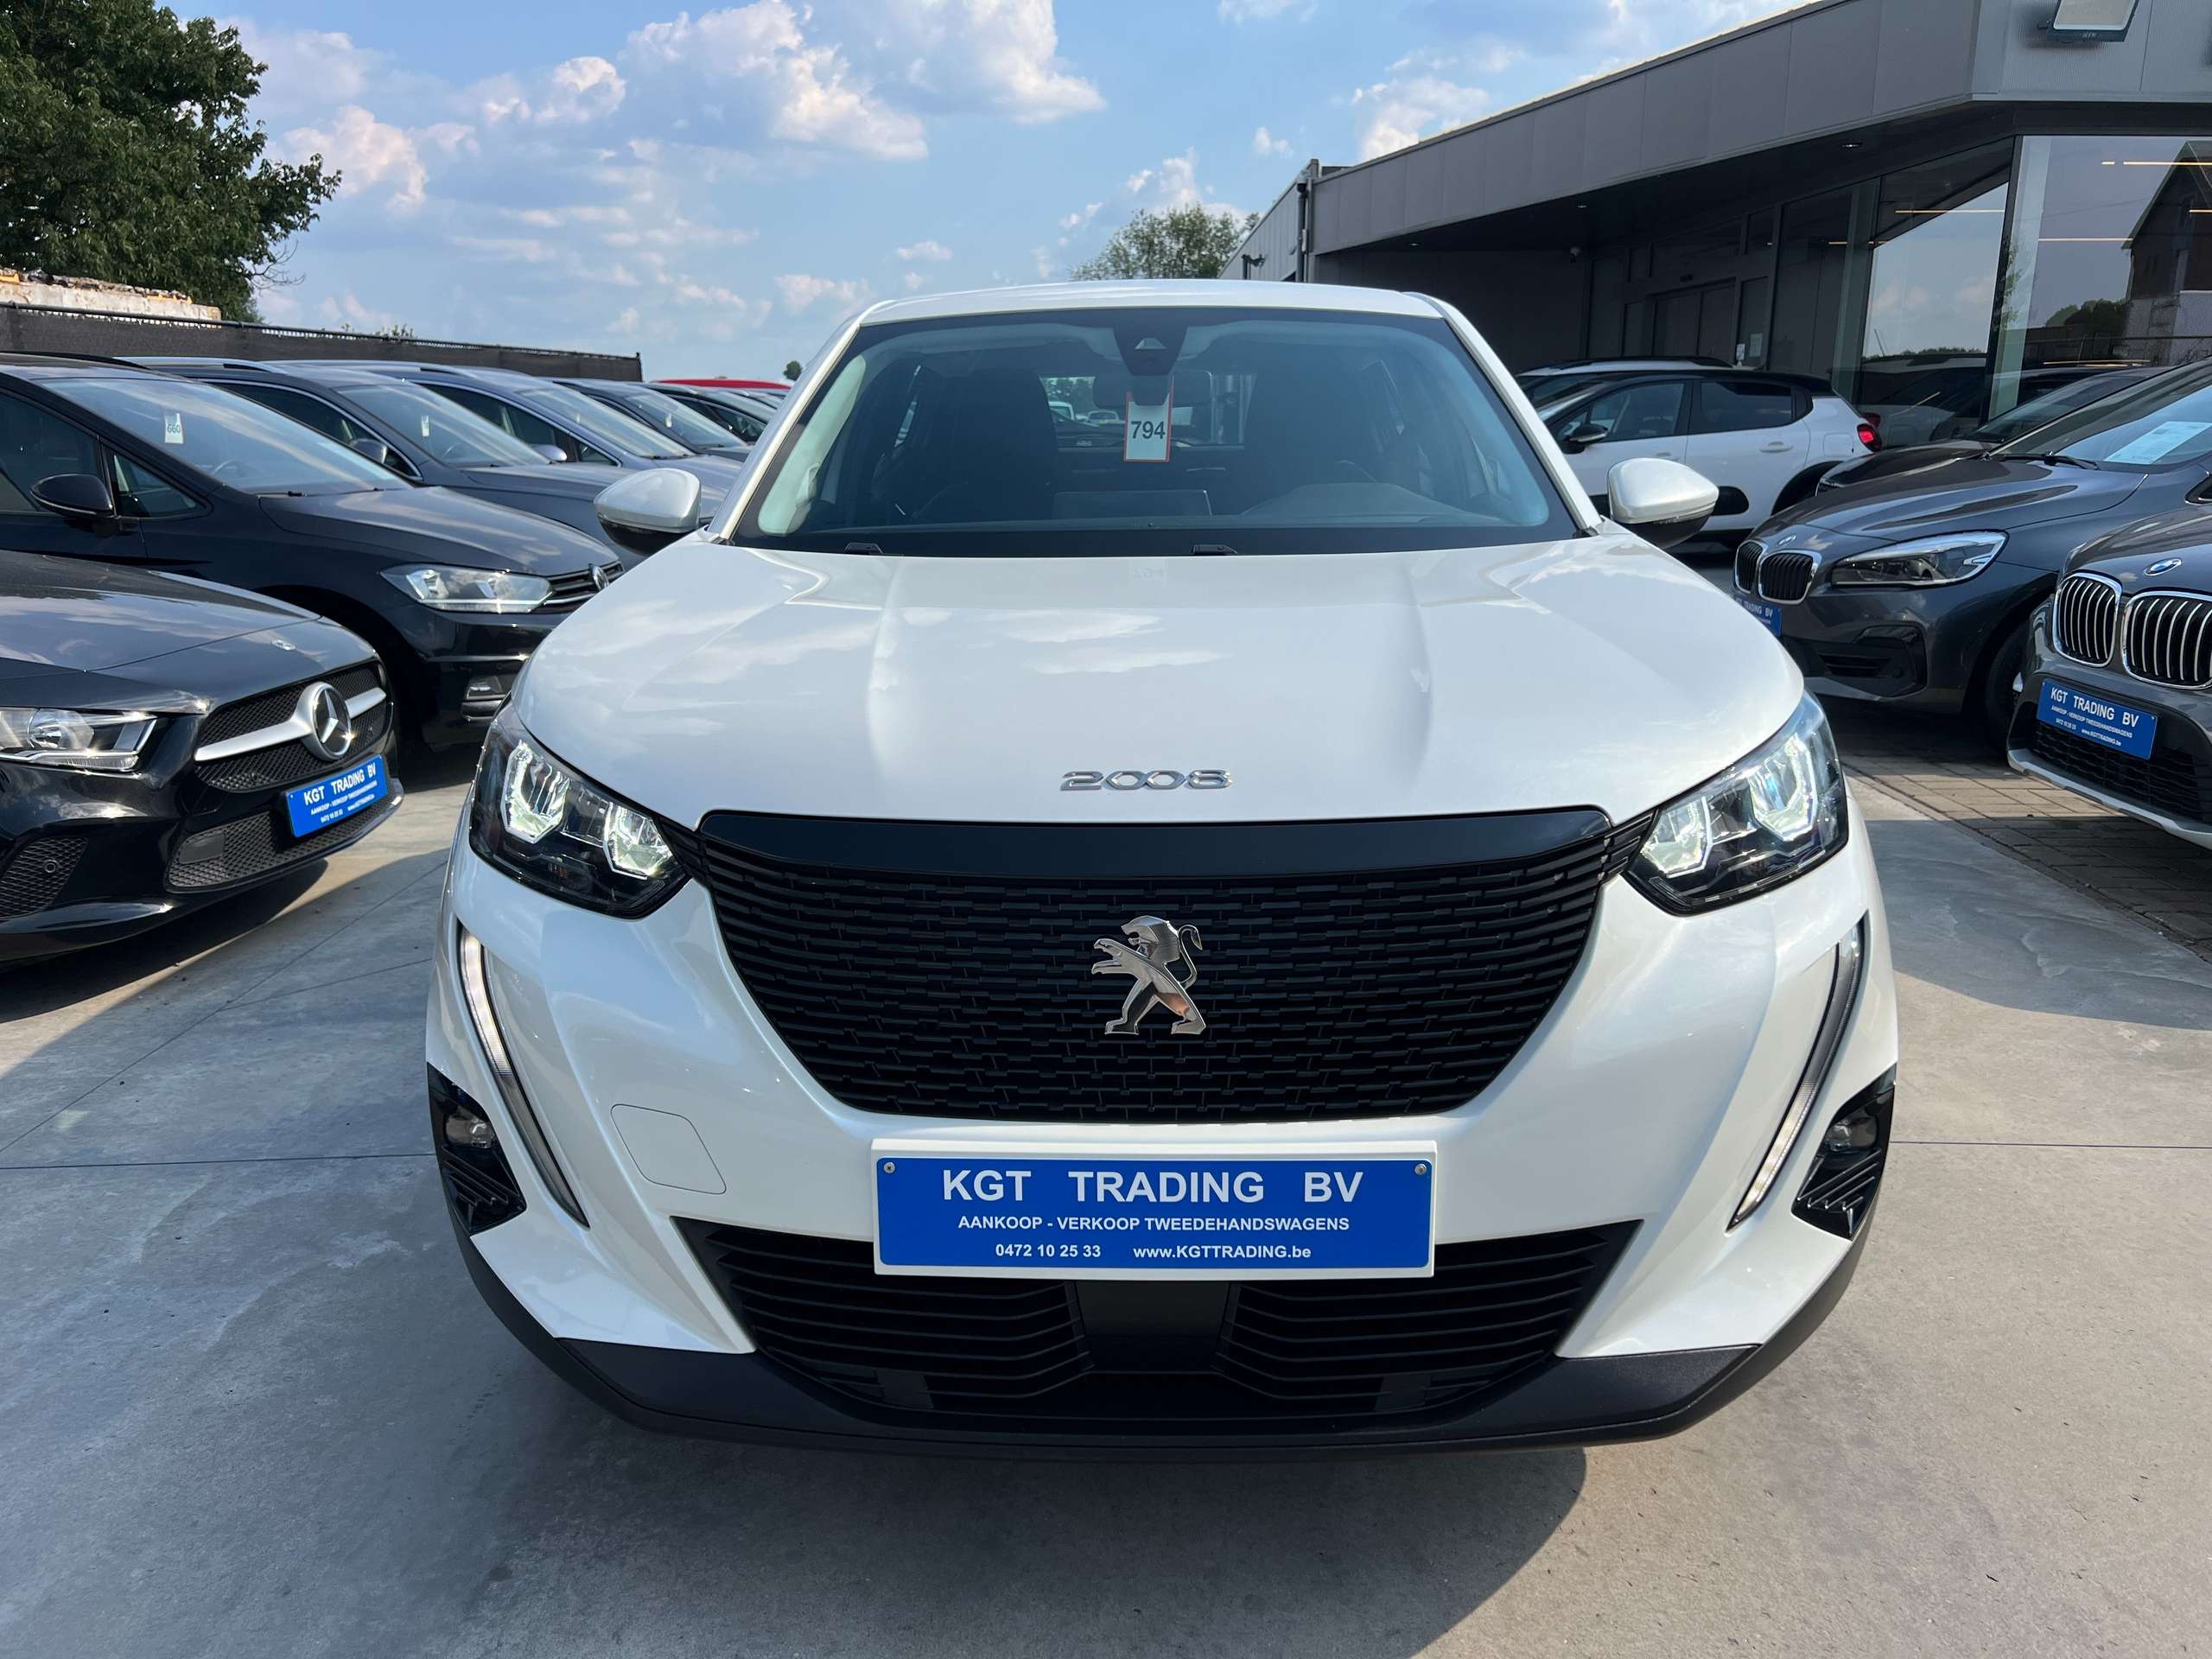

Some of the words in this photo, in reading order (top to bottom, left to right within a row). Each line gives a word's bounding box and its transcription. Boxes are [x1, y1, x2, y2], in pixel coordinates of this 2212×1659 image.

[1131, 421, 1166, 439] 794
[2050, 687, 2068, 703] KGT
[2074, 696, 2114, 720] TRADING
[2122, 712, 2139, 728] BV
[303, 785, 325, 805] KGT
[331, 769, 365, 794] TRADING
[367, 762, 376, 778] BV
[1060, 769, 1233, 791] 2008
[943, 1169, 1032, 1201] KGT
[1068, 1171, 1264, 1203] TRADING
[1304, 1172, 1363, 1203] BV
[958, 1216, 1043, 1230] AANKOOP
[1057, 1217, 1140, 1230] VERKOOP
[1145, 1217, 1350, 1230] TWEEDEHANDSWAGENS
[995, 1244, 1032, 1257] 0472
[1038, 1244, 1055, 1257] 10
[1059, 1244, 1078, 1257] 25
[1083, 1245, 1101, 1257] 33
[1134, 1245, 1311, 1258] www.KGTTRADING.be
